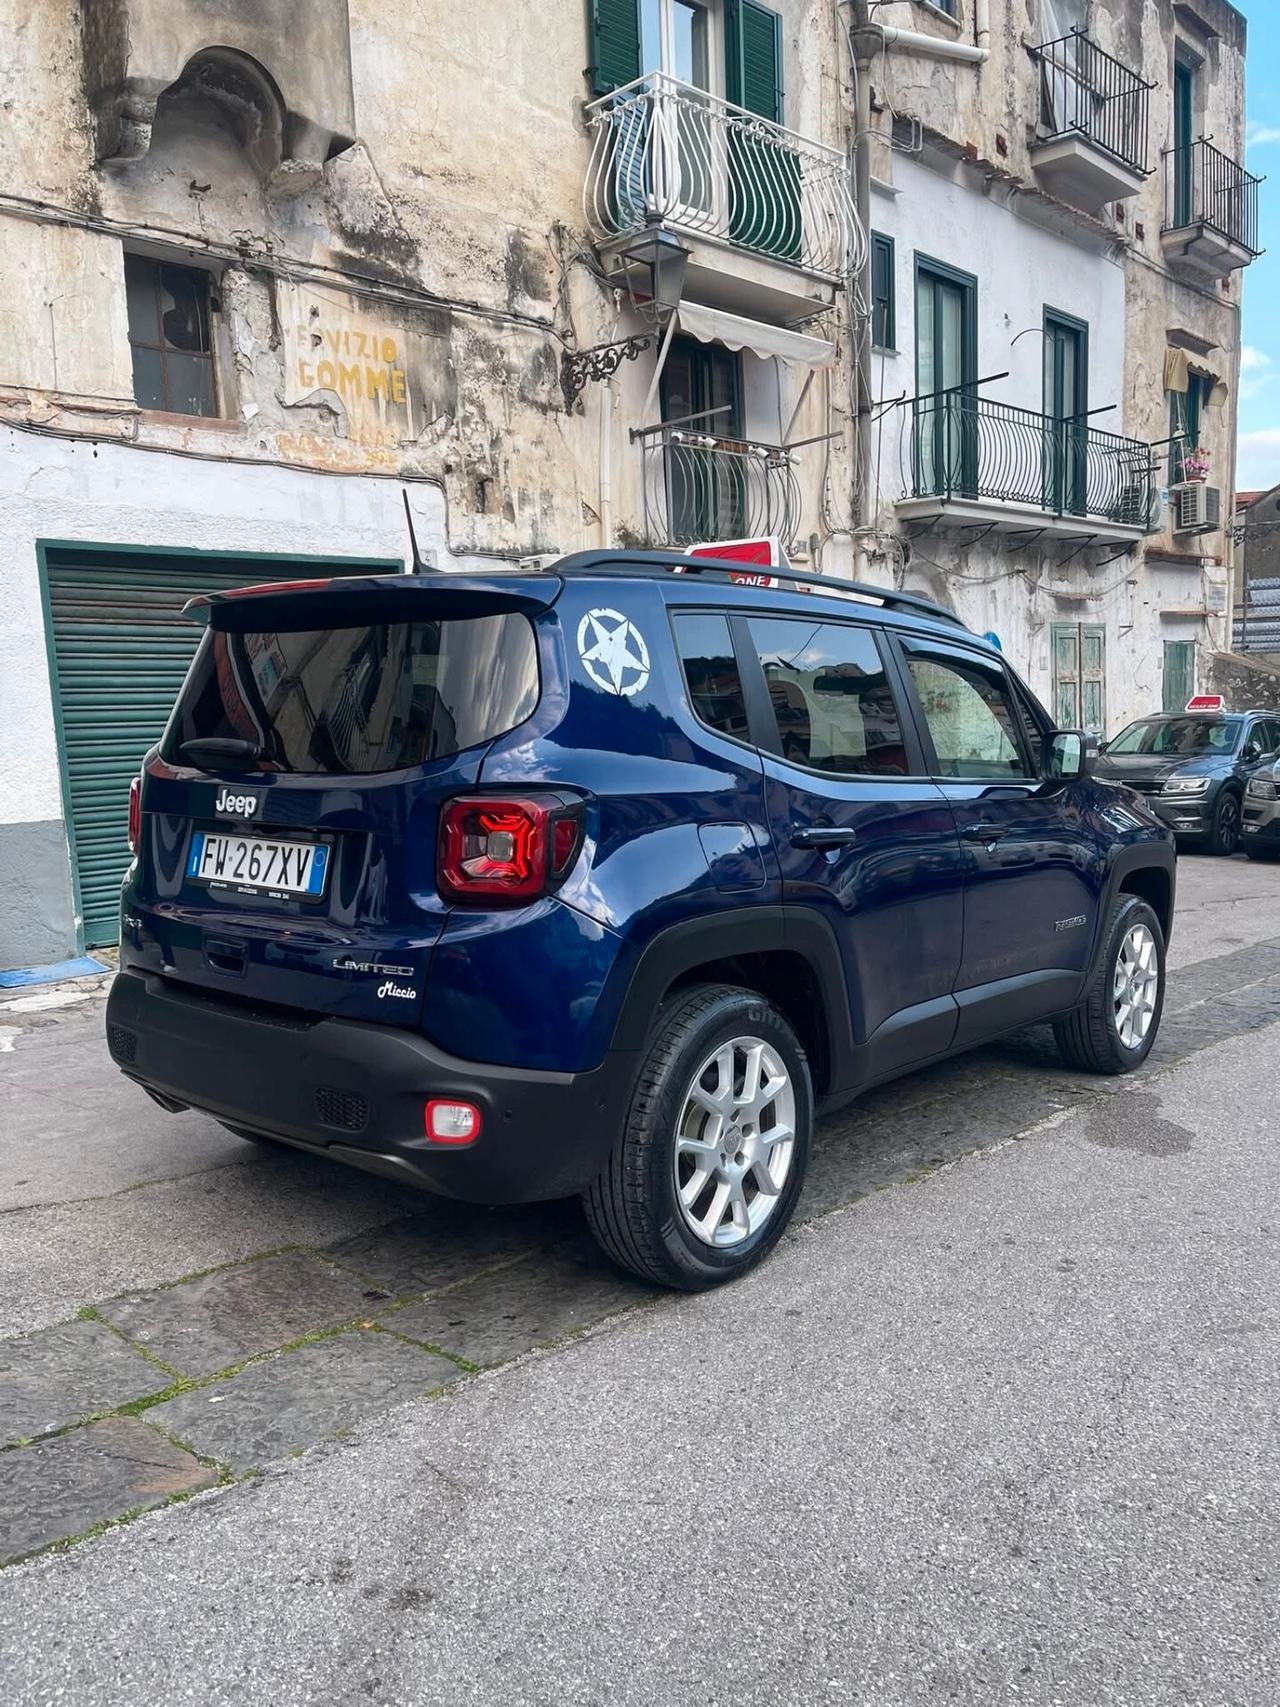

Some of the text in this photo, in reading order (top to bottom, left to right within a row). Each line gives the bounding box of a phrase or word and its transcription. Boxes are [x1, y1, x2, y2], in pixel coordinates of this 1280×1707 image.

[298, 358, 408, 405] GOMME
[215, 789, 257, 818] Jeep
[332, 959, 415, 976] LIMITED
[377, 980, 417, 999] Miccio
